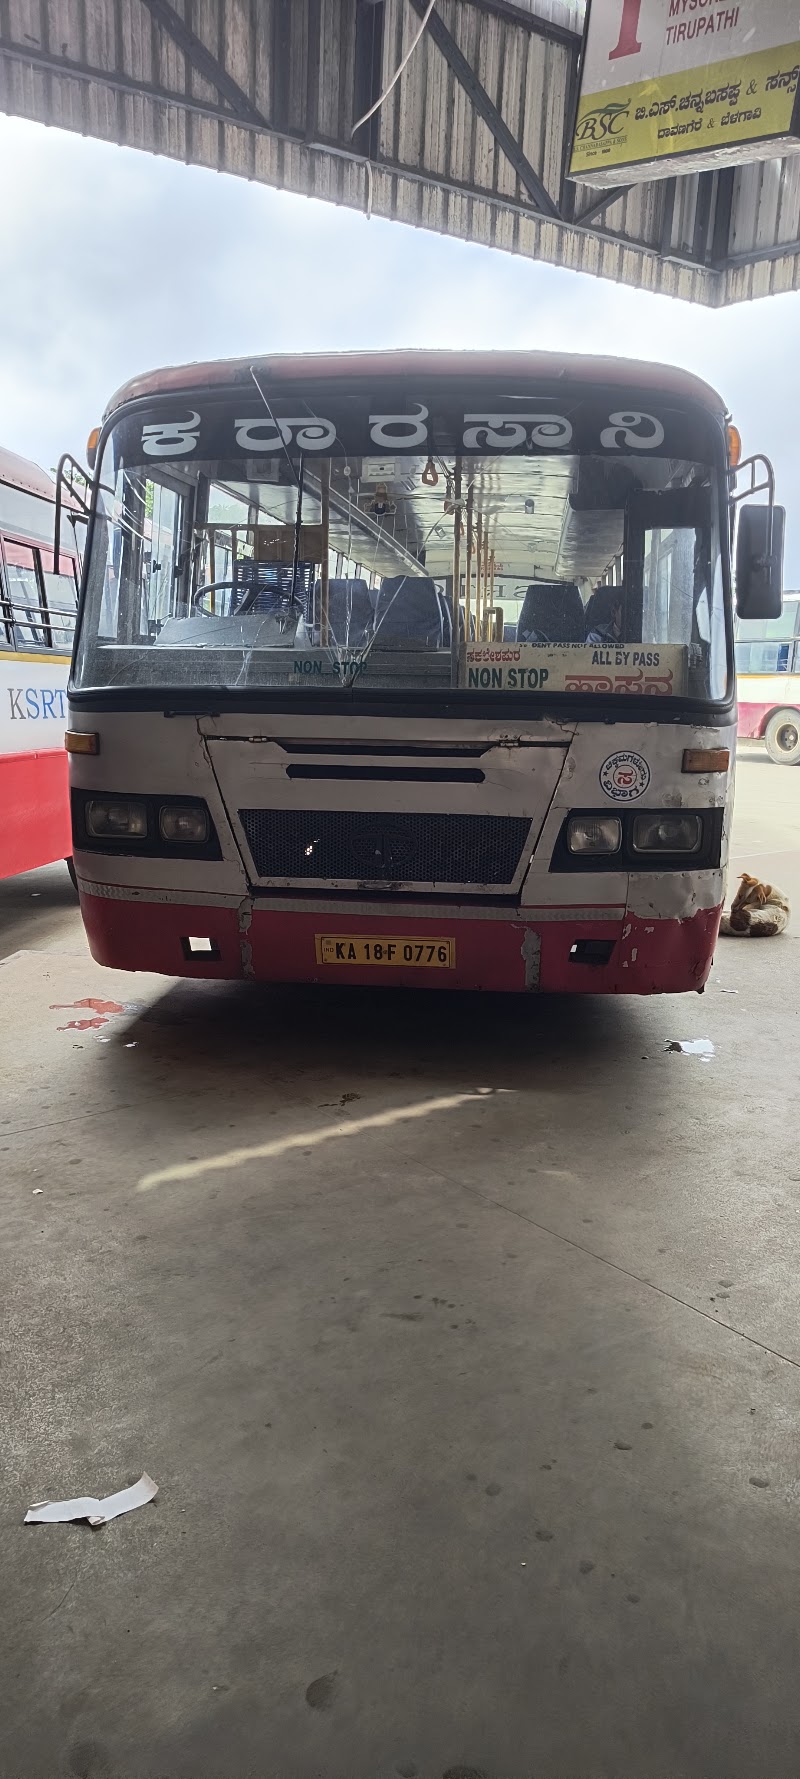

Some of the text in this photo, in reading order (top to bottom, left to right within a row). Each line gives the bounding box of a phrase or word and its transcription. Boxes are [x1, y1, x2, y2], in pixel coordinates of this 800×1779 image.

[666, 7, 739, 46] TIRUPATHI
[746, 79, 758, 95] &
[575, 110, 630, 141] BSC
[657, 106, 762, 139] ದಾವಣಗೆರೆ & ಬೆಳಗಾವಿ
[293, 660, 368, 675] NON STOP
[592, 651, 611, 665] ALL
[632, 652, 660, 667] PASS
[468, 668, 549, 689] NON STOP
[565, 668, 674, 696] ಹಾಸನ
[7, 688, 67, 720] KSRT
[335, 942, 357, 960] KA
[403, 944, 447, 963] 0776
